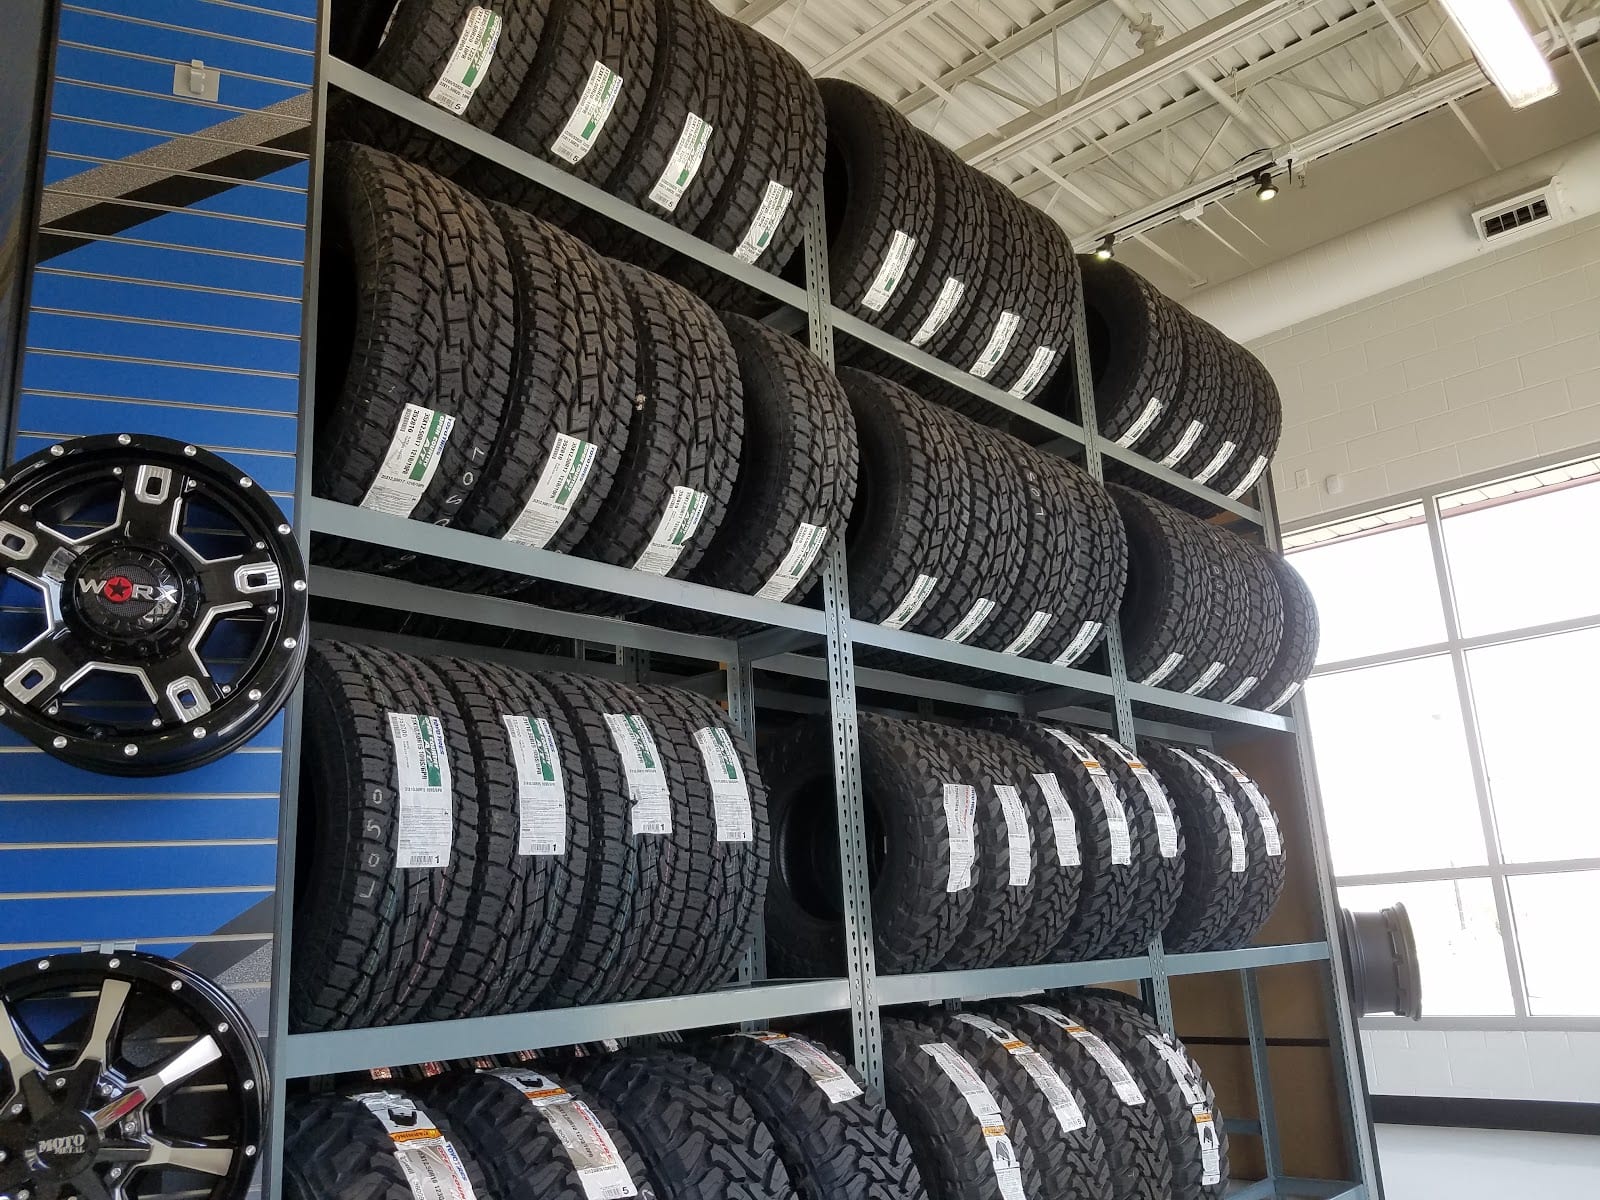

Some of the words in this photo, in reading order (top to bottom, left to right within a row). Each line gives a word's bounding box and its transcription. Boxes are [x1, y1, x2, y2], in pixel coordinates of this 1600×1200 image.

[488, 15, 500, 36] OPEN
[474, 37, 492, 71] COUNTRY
[454, 102, 461, 110] 5
[571, 154, 578, 162] 5
[434, 415, 445, 435] OPEN
[442, 418, 452, 436] TOYO
[419, 437, 431, 459] A/T
[422, 436, 437, 467] COUNTRY
[435, 434, 446, 456] TIRES
[566, 463, 581, 492] COUNTRY
[424, 716, 433, 736] OPEN
[429, 736, 439, 770] COUNTRY
[432, 718, 440, 734] TOYO
[436, 735, 444, 755] TIRES
[552, 843, 557, 851] 1
[434, 855, 439, 863] 1
[38, 1134, 85, 1153] MOTO
[437, 1146, 453, 1171] OPEN
[445, 1143, 458, 1161] TOYO
[453, 1160, 467, 1182] TIRES
